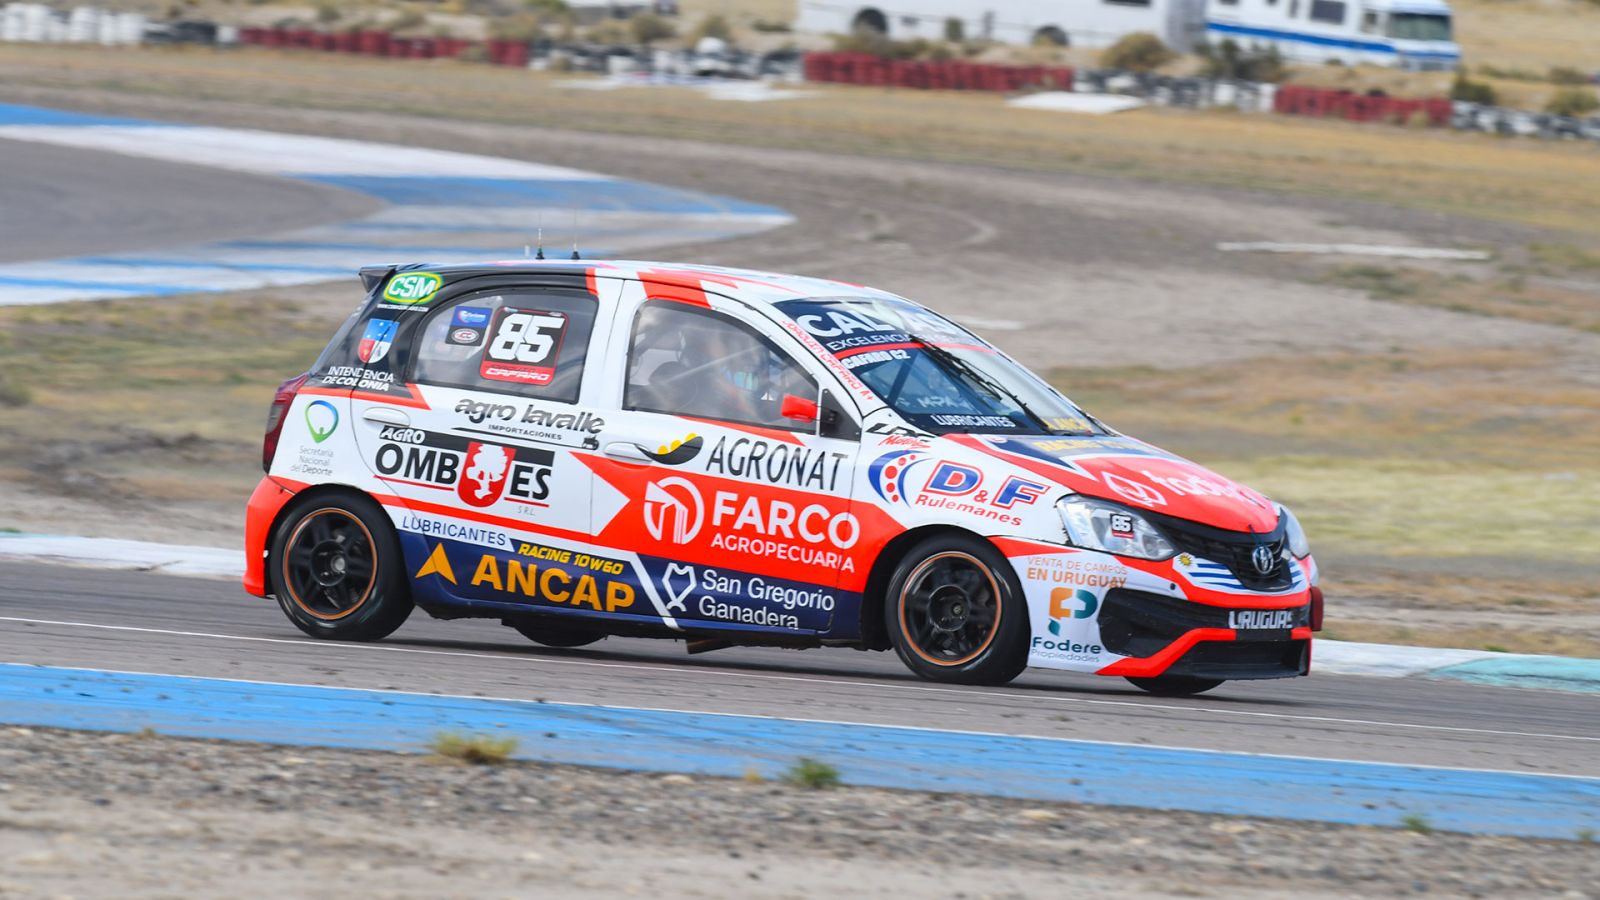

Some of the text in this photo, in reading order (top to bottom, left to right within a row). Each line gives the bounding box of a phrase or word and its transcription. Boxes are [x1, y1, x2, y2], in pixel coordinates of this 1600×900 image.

[388, 276, 437, 298] CSM
[488, 313, 566, 364] 85
[485, 367, 551, 381] CAFARO
[454, 398, 605, 434] agro lavalle
[930, 414, 1016, 428] LUBRICANTES
[380, 427, 426, 444] AGRO
[487, 423, 563, 441] IMPORTACIONES
[302, 464, 333, 477] Deporte
[705, 435, 849, 491] AGRONAT
[711, 490, 861, 550] FARCO
[914, 494, 1023, 526] Rulemanes
[1111, 514, 1132, 532] 85
[402, 515, 507, 546] LUBRICANTES
[517, 543, 624, 575] RACING 10W60
[710, 532, 856, 573] AGROPECUARIA
[1027, 556, 1128, 576] VENTA DE CAMPOS
[470, 554, 636, 613] ANCAP
[701, 568, 836, 611] San Gregorio
[1026, 567, 1127, 588] EN URUGUAY
[698, 595, 799, 631] Ganadera
[1032, 636, 1102, 655] Fodere
